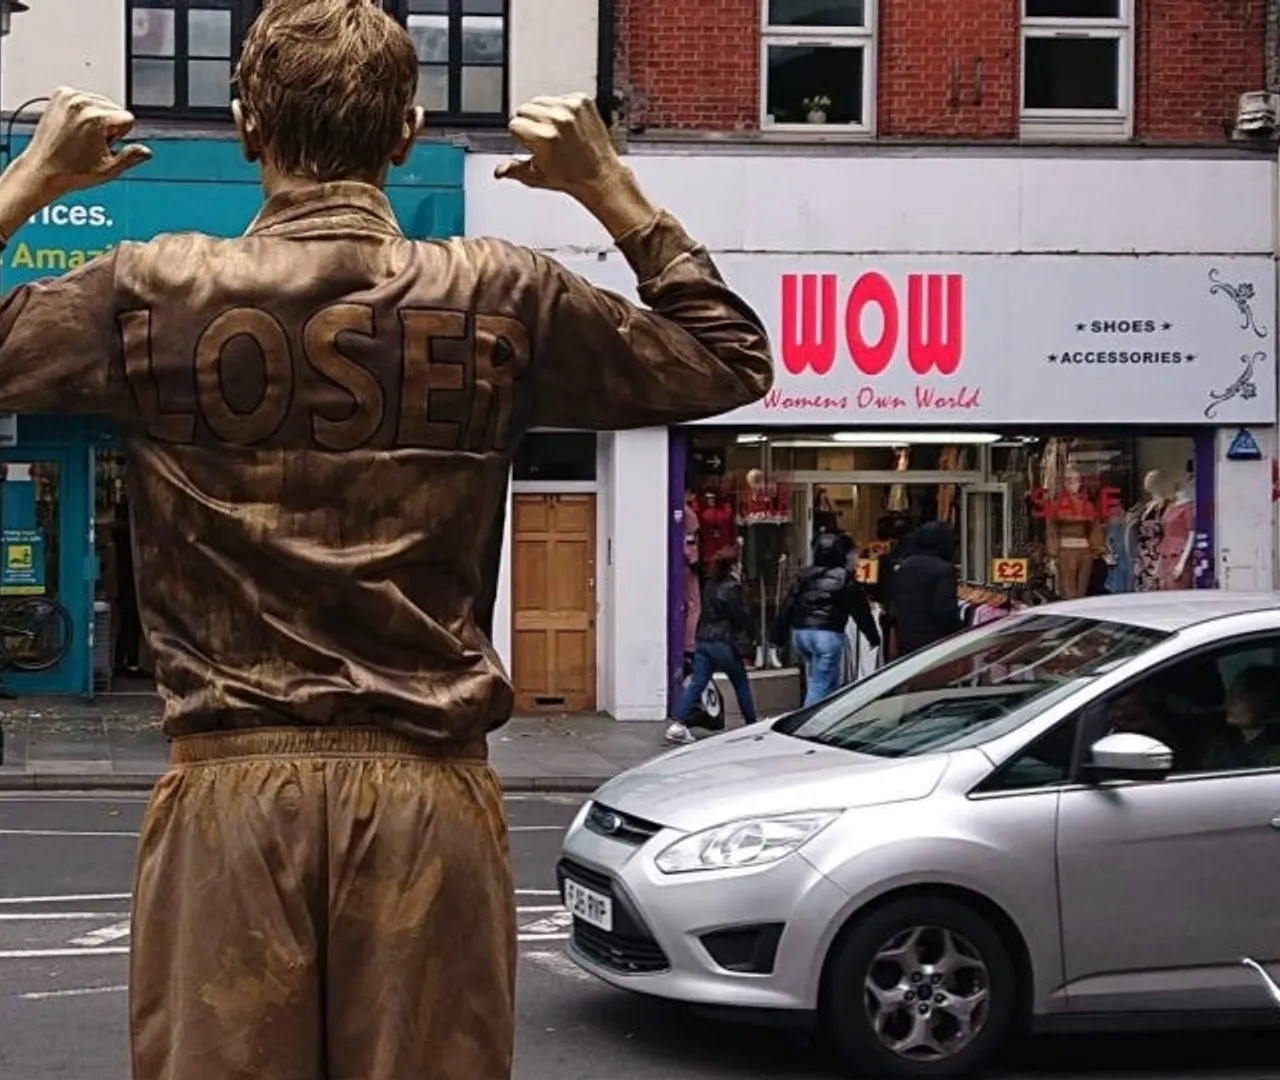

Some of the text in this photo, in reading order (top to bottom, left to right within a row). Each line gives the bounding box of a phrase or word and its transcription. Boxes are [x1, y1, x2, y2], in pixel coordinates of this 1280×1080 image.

[781, 271, 963, 375] WOW
[1090, 320, 1156, 333] SHOES
[1059, 351, 1182, 364] ACCESSORIES
[116, 302, 532, 450] LOSER
[763, 384, 982, 409] Womens Own World
[997, 562, 1024, 577] £2
